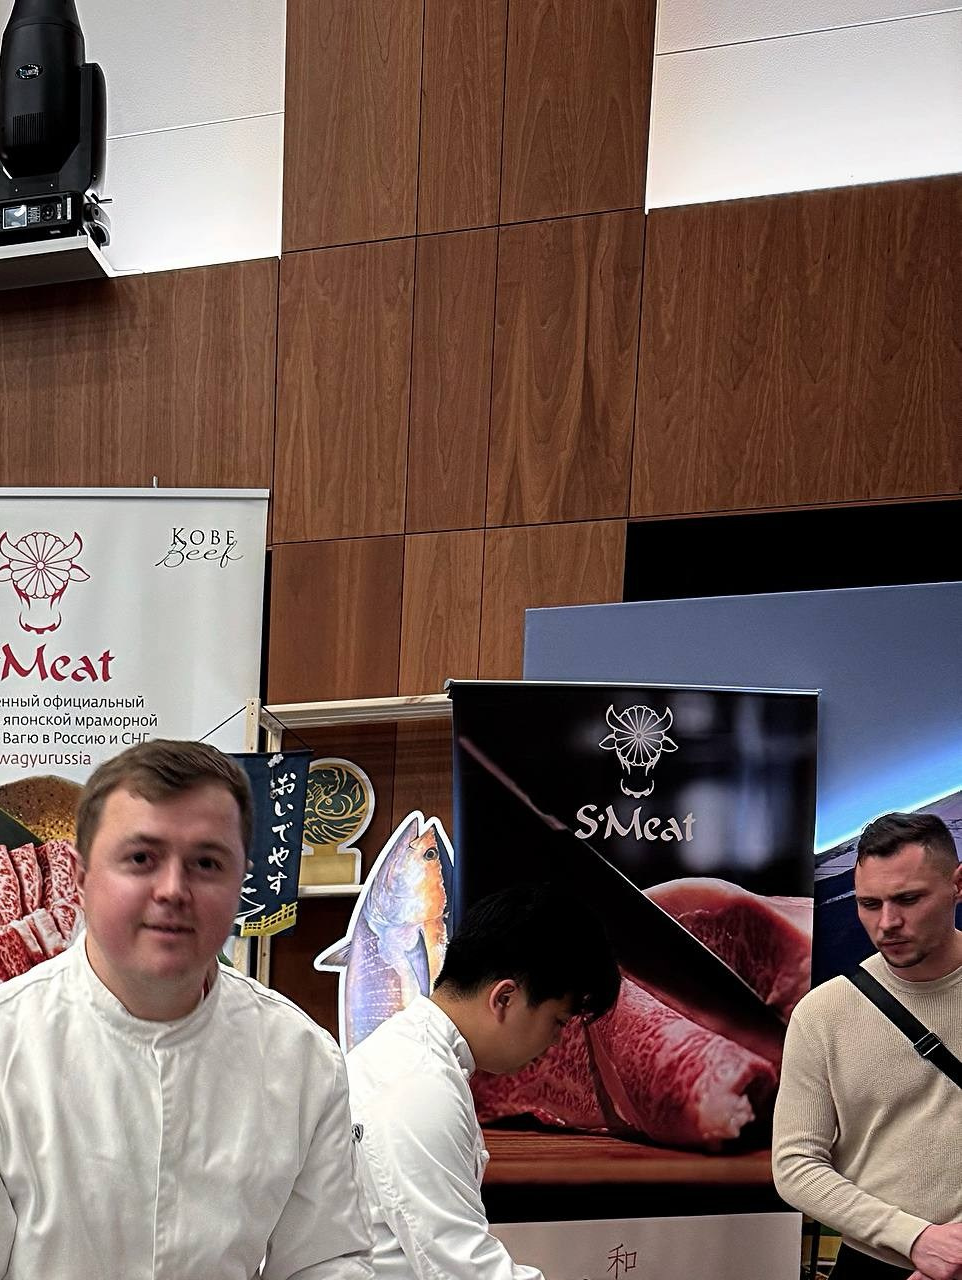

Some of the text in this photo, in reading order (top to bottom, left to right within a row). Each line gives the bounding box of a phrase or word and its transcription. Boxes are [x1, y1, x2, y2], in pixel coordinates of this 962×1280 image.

[171, 527, 235, 546] KOBE
[155, 540, 244, 568] Beef
[43, 694, 145, 710] официальный
[3, 713, 72, 727] японской
[75, 713, 158, 730] мраморной
[2, 732, 39, 744] Вагю
[42, 735, 50, 744] в
[54, 732, 106, 745] Россию
[109, 735, 118, 745] и
[121, 732, 151, 745] СНГ
[267, 772, 297, 896] おいでやす
[607, 1243, 637, 1280] 和
